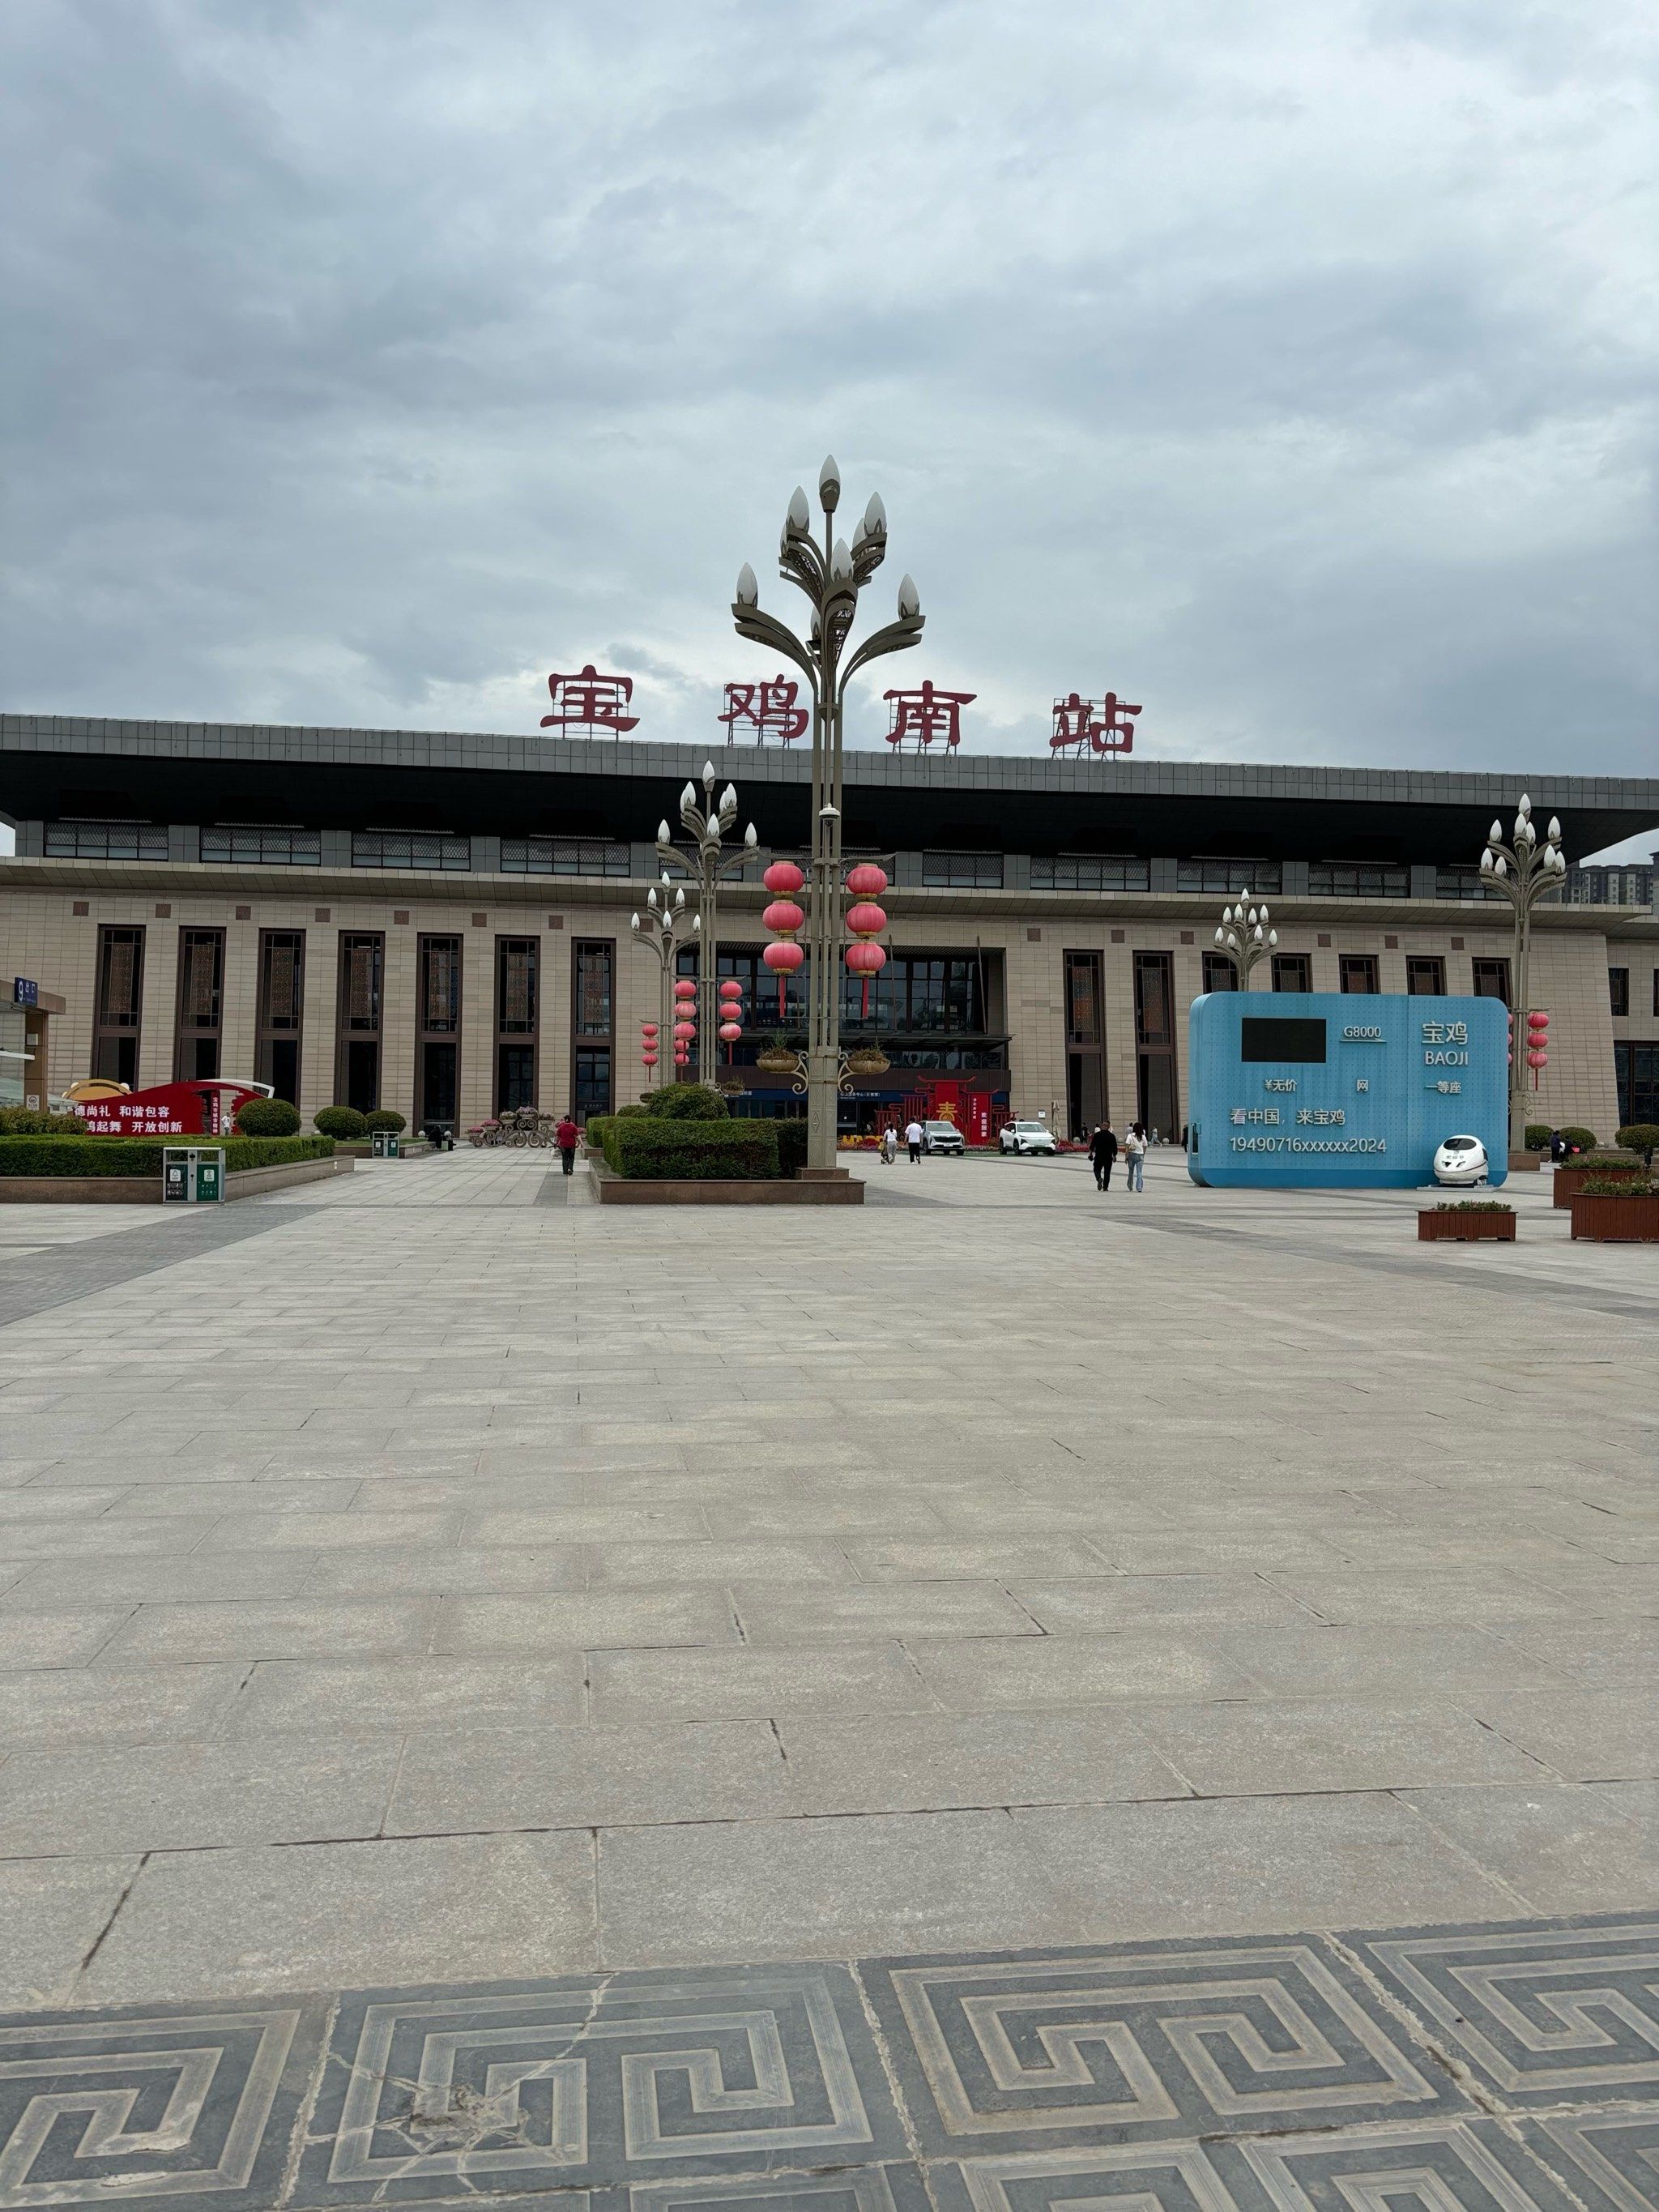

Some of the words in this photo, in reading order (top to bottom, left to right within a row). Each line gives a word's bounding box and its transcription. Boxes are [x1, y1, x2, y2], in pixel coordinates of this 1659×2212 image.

[539, 664, 1142, 754] 宝鸡南站
[18, 980, 24, 1002] 9
[1343, 1026, 1382, 1039] G8000
[1421, 1020, 1469, 1045] 宝鸡
[1424, 1051, 1469, 1066] BAOJI
[1265, 1078, 1297, 1092] ¥无价
[1356, 1079, 1369, 1092] 网
[1425, 1081, 1462, 1095] 一等座
[119, 1105, 169, 1117] 和谐包容
[131, 1121, 183, 1133] 开放创新
[1230, 1137, 1387, 1154] 19490716xxxxxx2024
